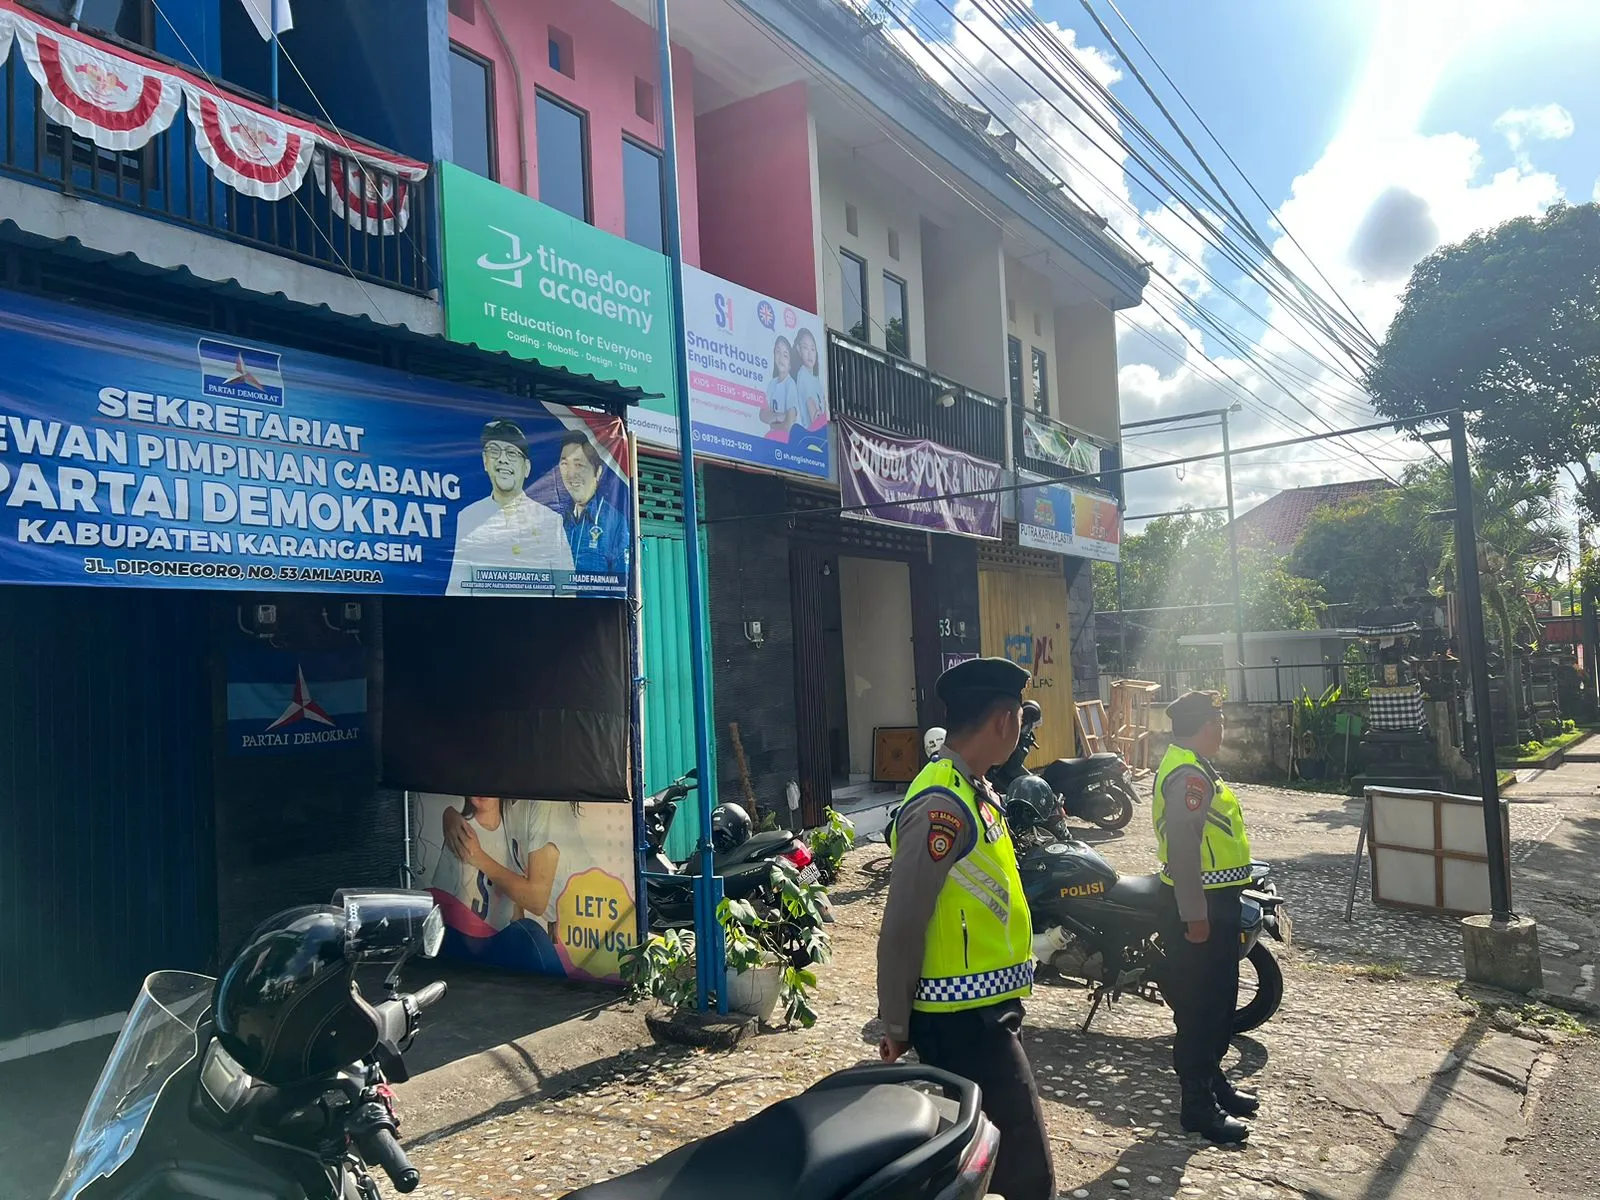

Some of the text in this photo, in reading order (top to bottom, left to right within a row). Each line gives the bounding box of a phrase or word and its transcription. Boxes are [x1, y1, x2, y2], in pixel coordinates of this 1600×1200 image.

[537, 244, 652, 307] timedoor
[538, 276, 653, 335] academy
[483, 301, 653, 363] IT Education for Everyone
[687, 330, 769, 369] SmartHouse
[507, 330, 638, 374] Coding Robotic Design STEM
[687, 349, 764, 383] English Course
[208, 384, 280, 402] PARTAI DEMOKRAT
[97, 387, 365, 451] SEKRETARIAT
[137, 433, 328, 487] PIMPINAN
[333, 460, 461, 500] CABANG
[952, 459, 961, 494] &
[0, 462, 447, 538] ARTAI DEMOKRAT
[18, 518, 423, 563] KABUPATEN KARANGASEM
[84, 557, 384, 584] JL. DIPONEGORO, NO. 53 AMLAPURA
[481, 571, 508, 580] WAYAN
[508, 572, 541, 582] SUPARTA,
[541, 573, 550, 582] SE
[242, 727, 360, 747] PARTAI DEMOKRAT
[575, 894, 619, 921] LET'S
[1060, 881, 1104, 898] POLISI
[565, 924, 600, 950] JOIN
